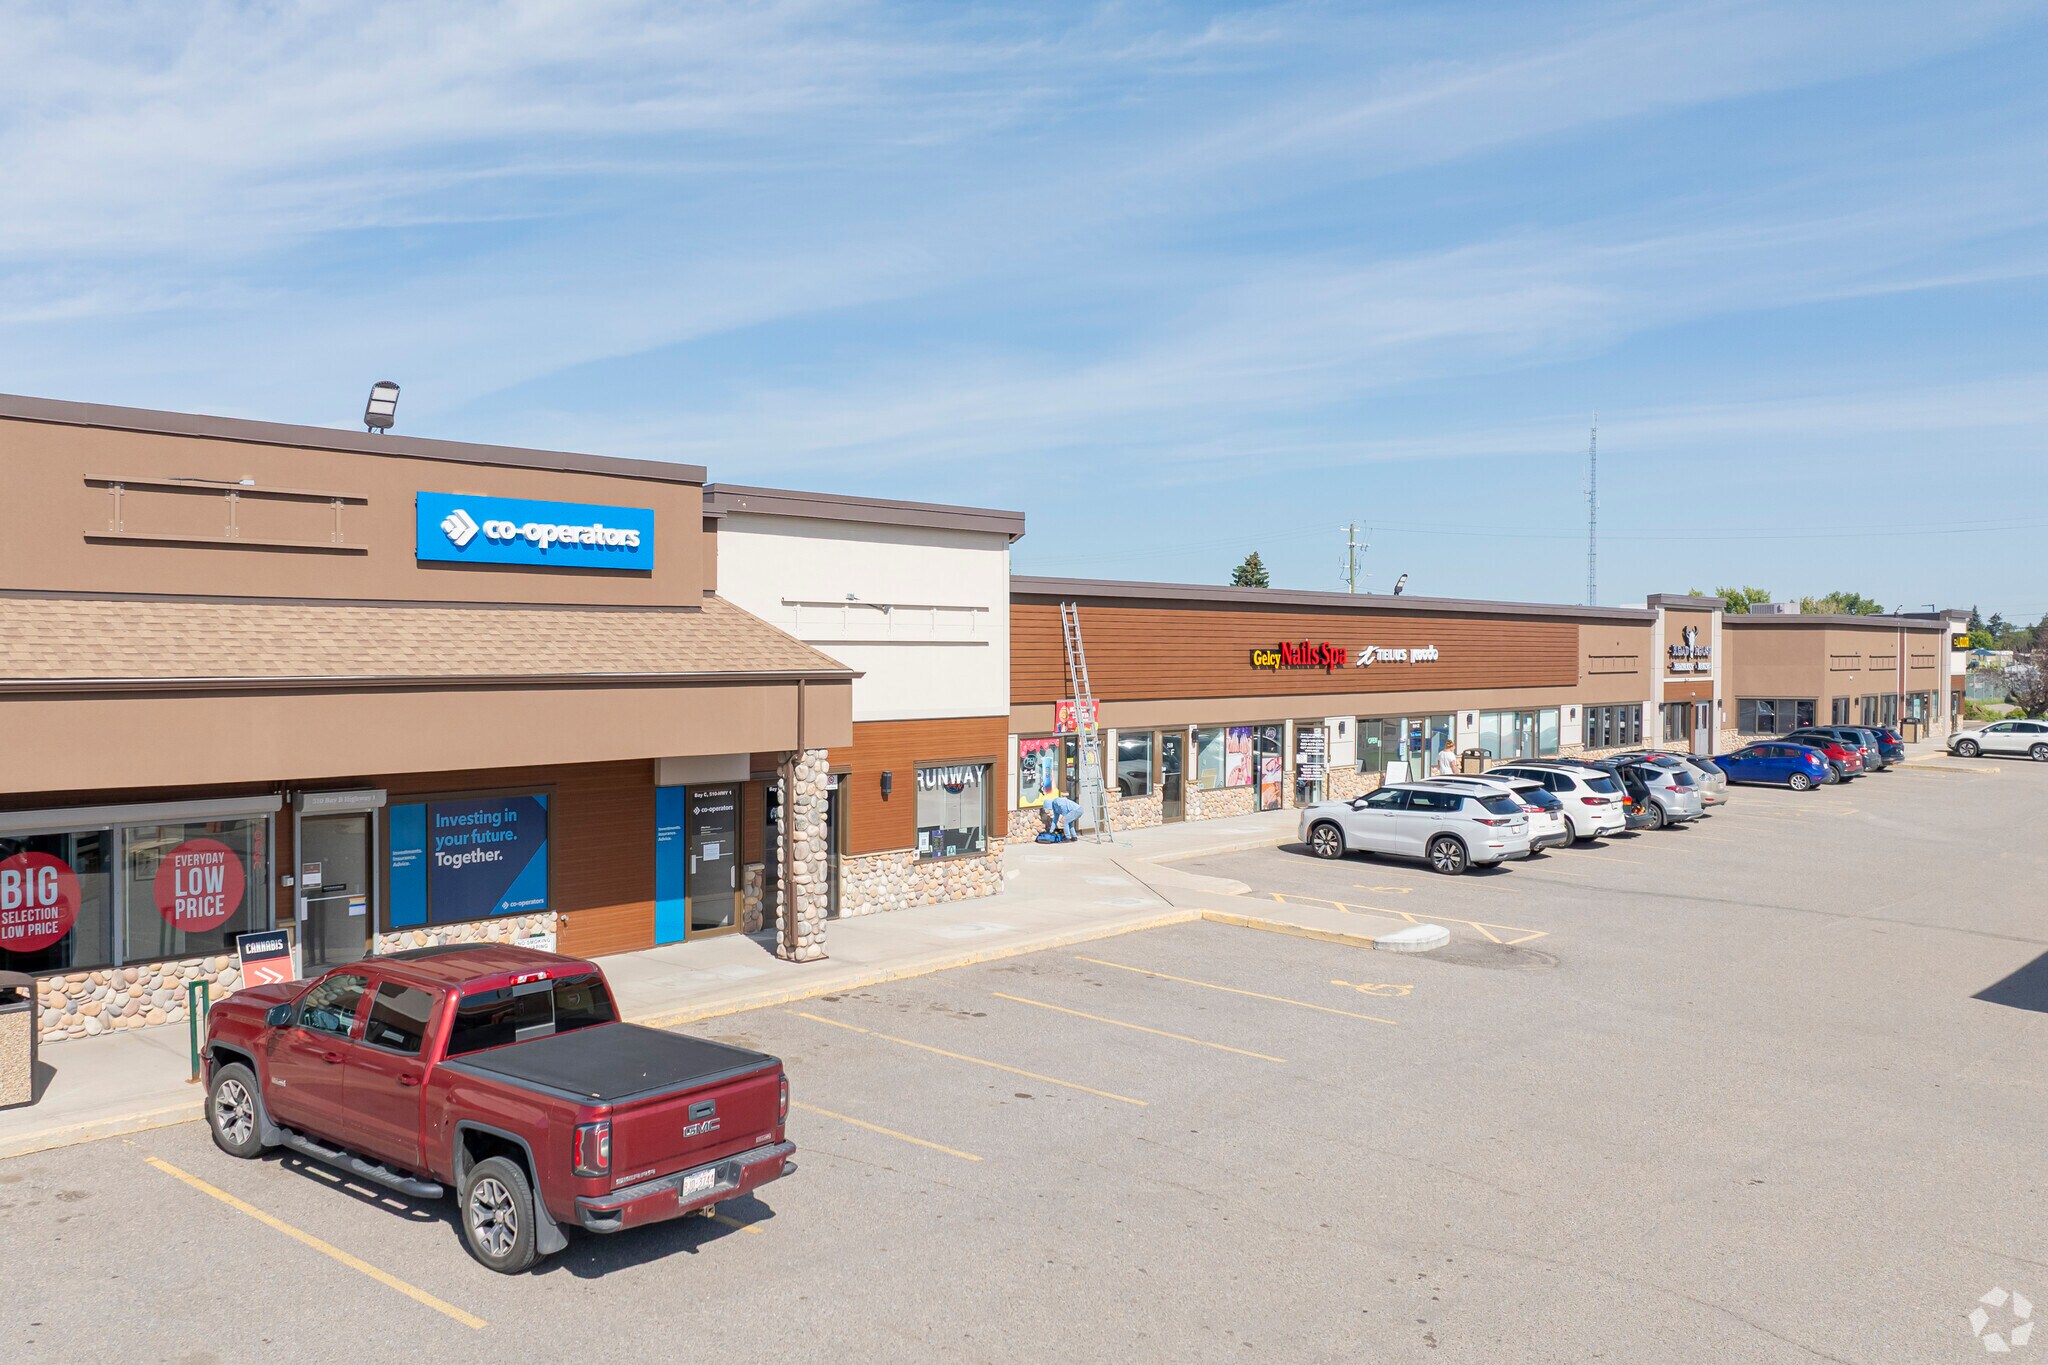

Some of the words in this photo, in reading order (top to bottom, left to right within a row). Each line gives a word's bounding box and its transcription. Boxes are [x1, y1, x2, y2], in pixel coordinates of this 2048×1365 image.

[482, 520, 640, 549] co-operators
[1253, 650, 1281, 669] Gelcy
[1281, 640, 1320, 665] Nails
[1321, 641, 1347, 671] Spa
[916, 764, 985, 788] RUNWAY
[435, 809, 502, 828] Investing
[504, 808, 517, 822] in
[701, 804, 734, 813] co-operators
[435, 833, 470, 851] your
[471, 829, 518, 844] future.
[174, 852, 226, 867] EVERYDAY
[435, 848, 503, 869] Together.
[1, 865, 59, 911] BIG
[174, 865, 226, 898] LOW
[175, 894, 226, 920] PRICE
[509, 897, 545, 909] co-operators
[1, 906, 59, 925] SELECTION
[1, 924, 25, 940] LOW
[28, 921, 59, 937] PRICE
[245, 938, 284, 955] CANNABIS
[683, 1117, 720, 1138] GMC
